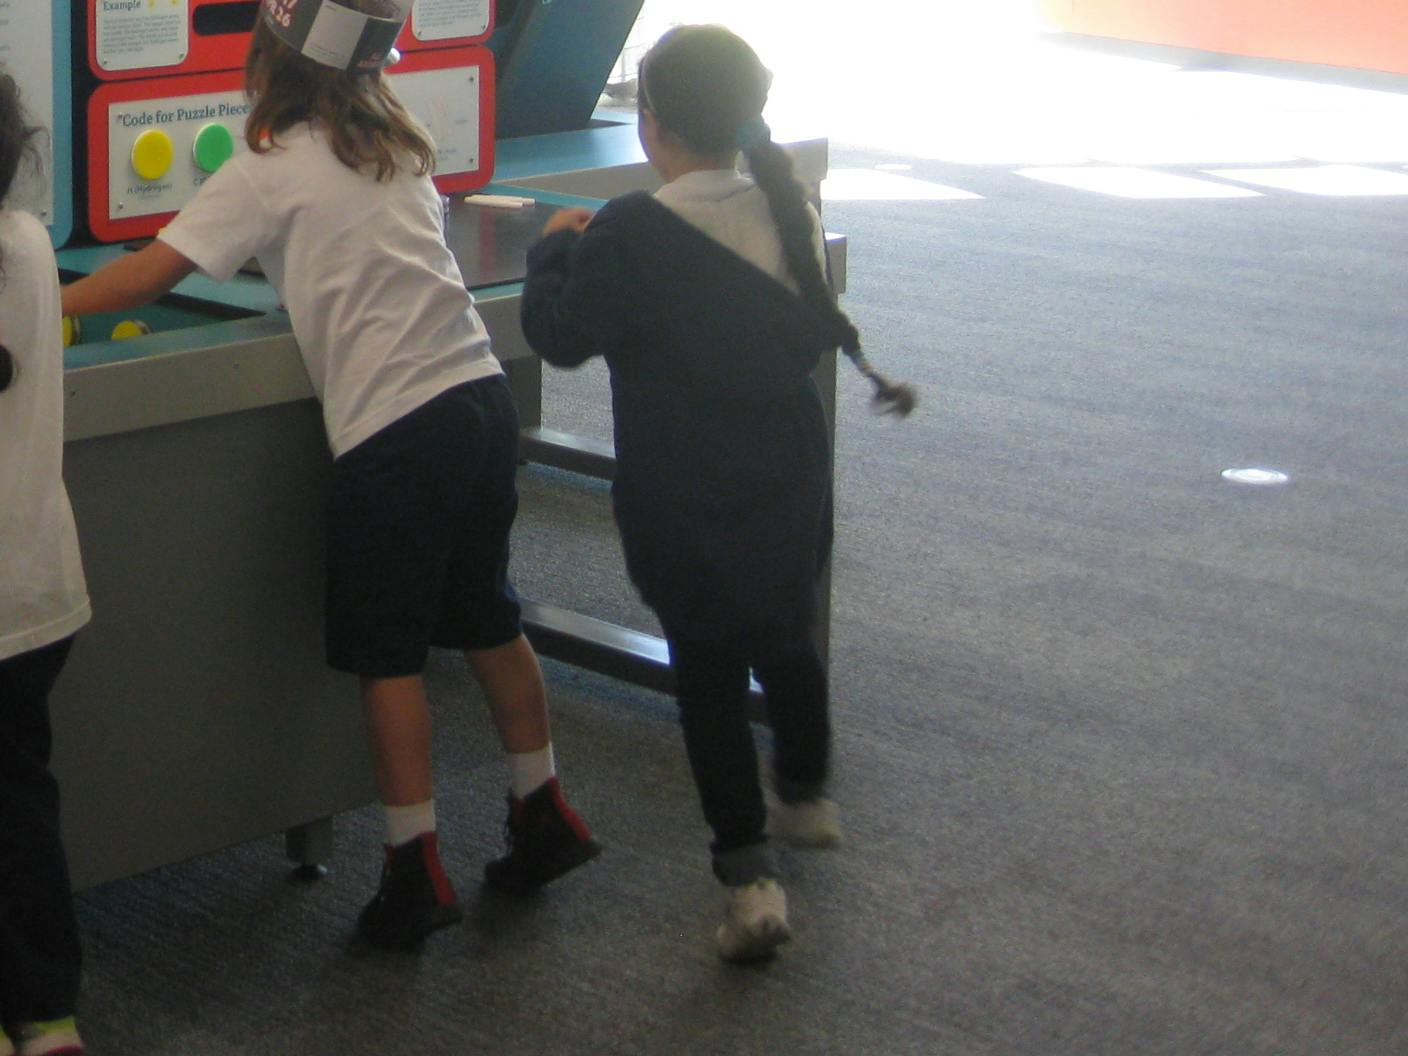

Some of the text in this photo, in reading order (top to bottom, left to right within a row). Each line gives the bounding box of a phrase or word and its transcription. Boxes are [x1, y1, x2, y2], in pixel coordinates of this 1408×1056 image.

[275, 5, 291, 27] 26
[156, 109, 173, 124] for
[176, 105, 216, 122] Puzzle
